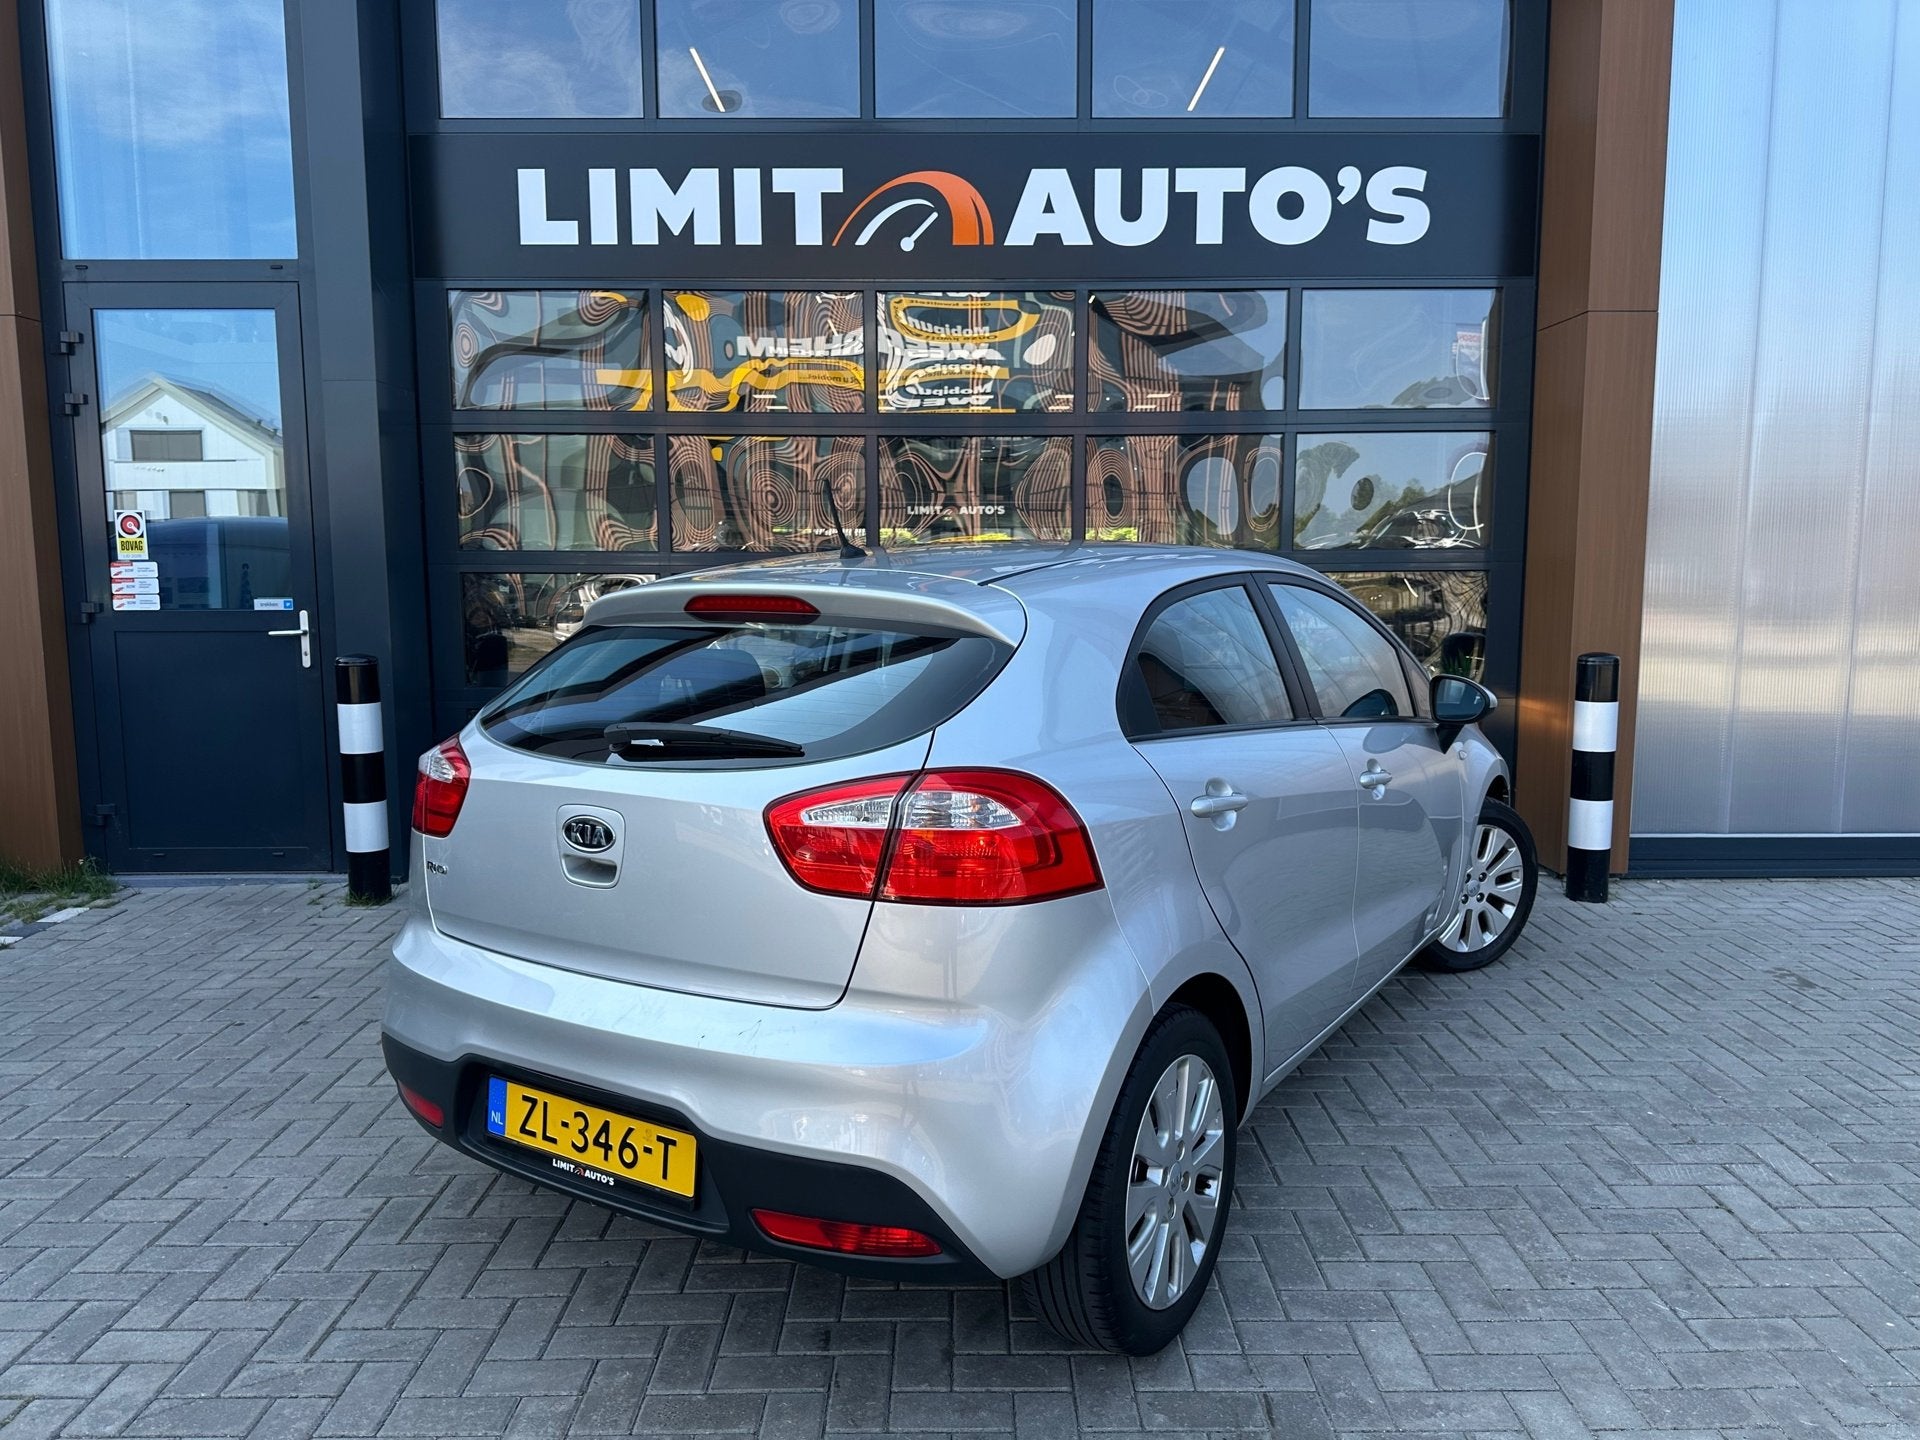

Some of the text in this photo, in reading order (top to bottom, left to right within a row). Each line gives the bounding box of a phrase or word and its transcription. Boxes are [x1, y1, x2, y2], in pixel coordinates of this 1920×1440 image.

[517, 165, 1431, 247] LIMIT AUTO'S
[907, 505, 1006, 516] LIMIT AUTO'S
[120, 540, 144, 551] BOVAG
[570, 822, 607, 846] KIA
[491, 1110, 504, 1126] NL
[519, 1094, 678, 1180] ZL-346-T
[552, 1158, 615, 1186] LIMIT AUTO'S
